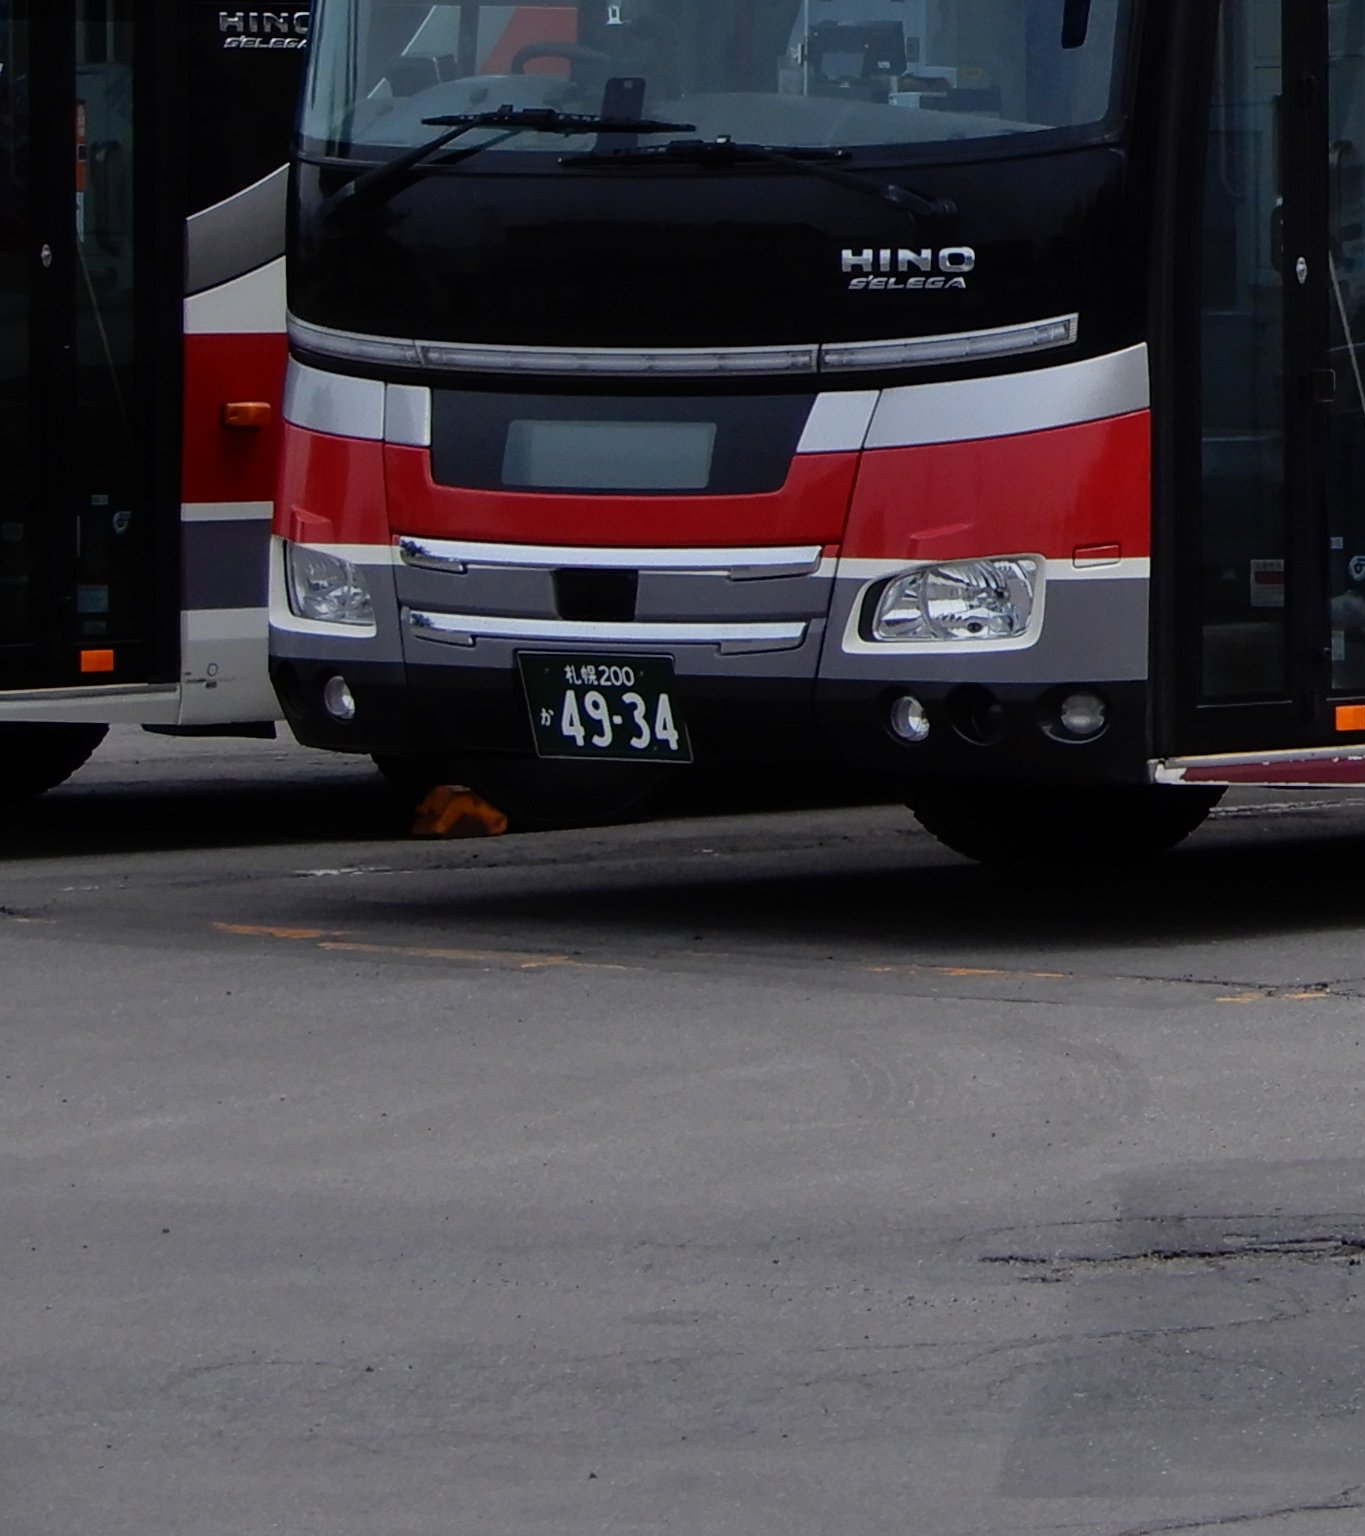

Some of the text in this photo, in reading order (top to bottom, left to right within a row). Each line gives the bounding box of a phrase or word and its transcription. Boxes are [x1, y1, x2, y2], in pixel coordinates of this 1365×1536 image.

[841, 246, 976, 273] HINO
[539, 689, 679, 751] か 49-34
